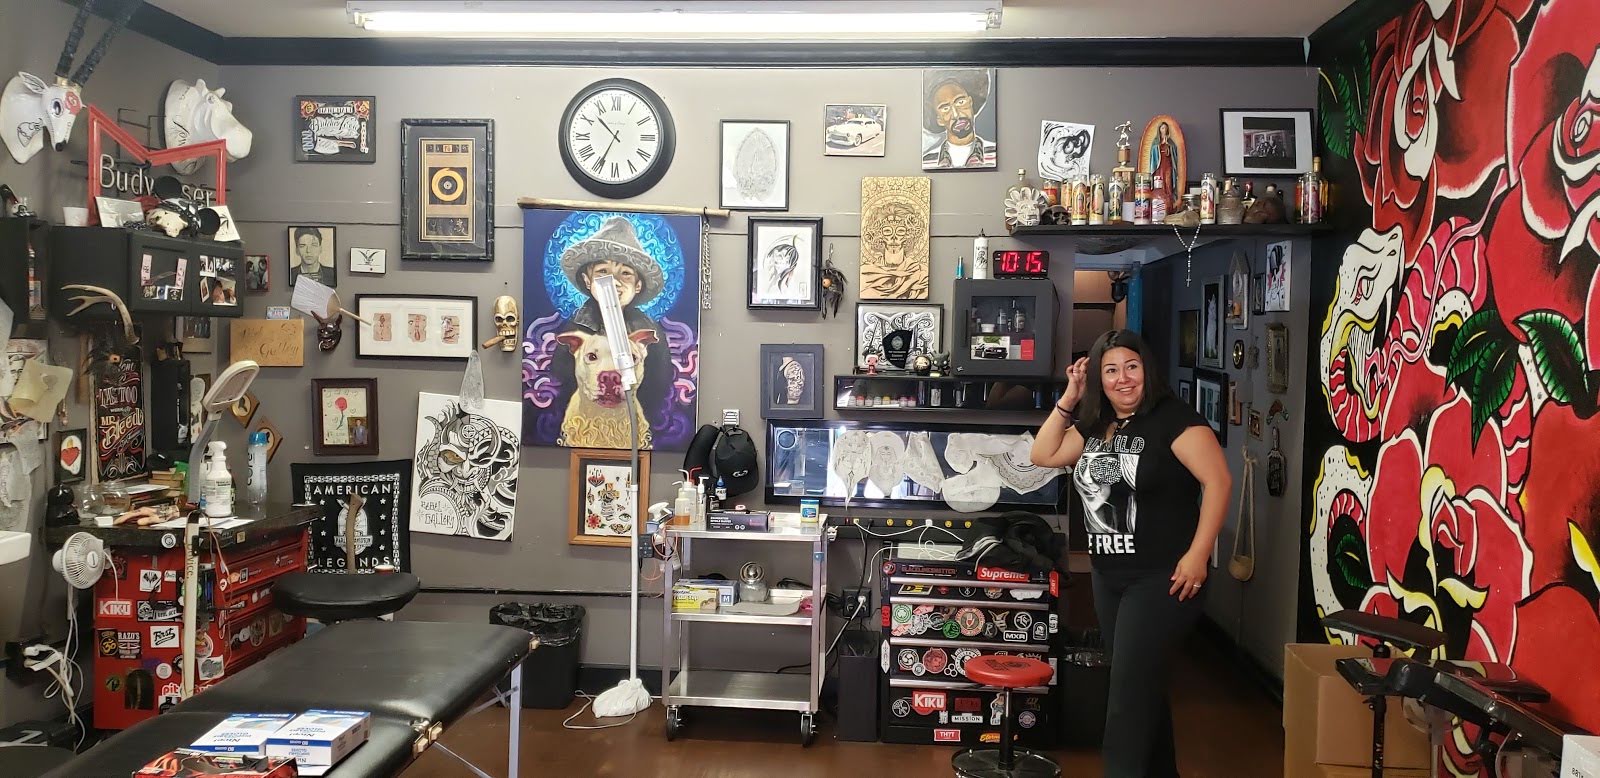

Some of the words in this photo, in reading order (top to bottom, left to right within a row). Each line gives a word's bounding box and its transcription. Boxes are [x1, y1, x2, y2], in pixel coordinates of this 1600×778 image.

[313, 483, 391, 495] AMERICAN
[1095, 534, 1136, 555] FREE
[318, 557, 390, 568] LEGNDS
[980, 567, 1026, 580] Supreme
[99, 601, 132, 616] KIKU
[914, 693, 945, 709] KIKU
